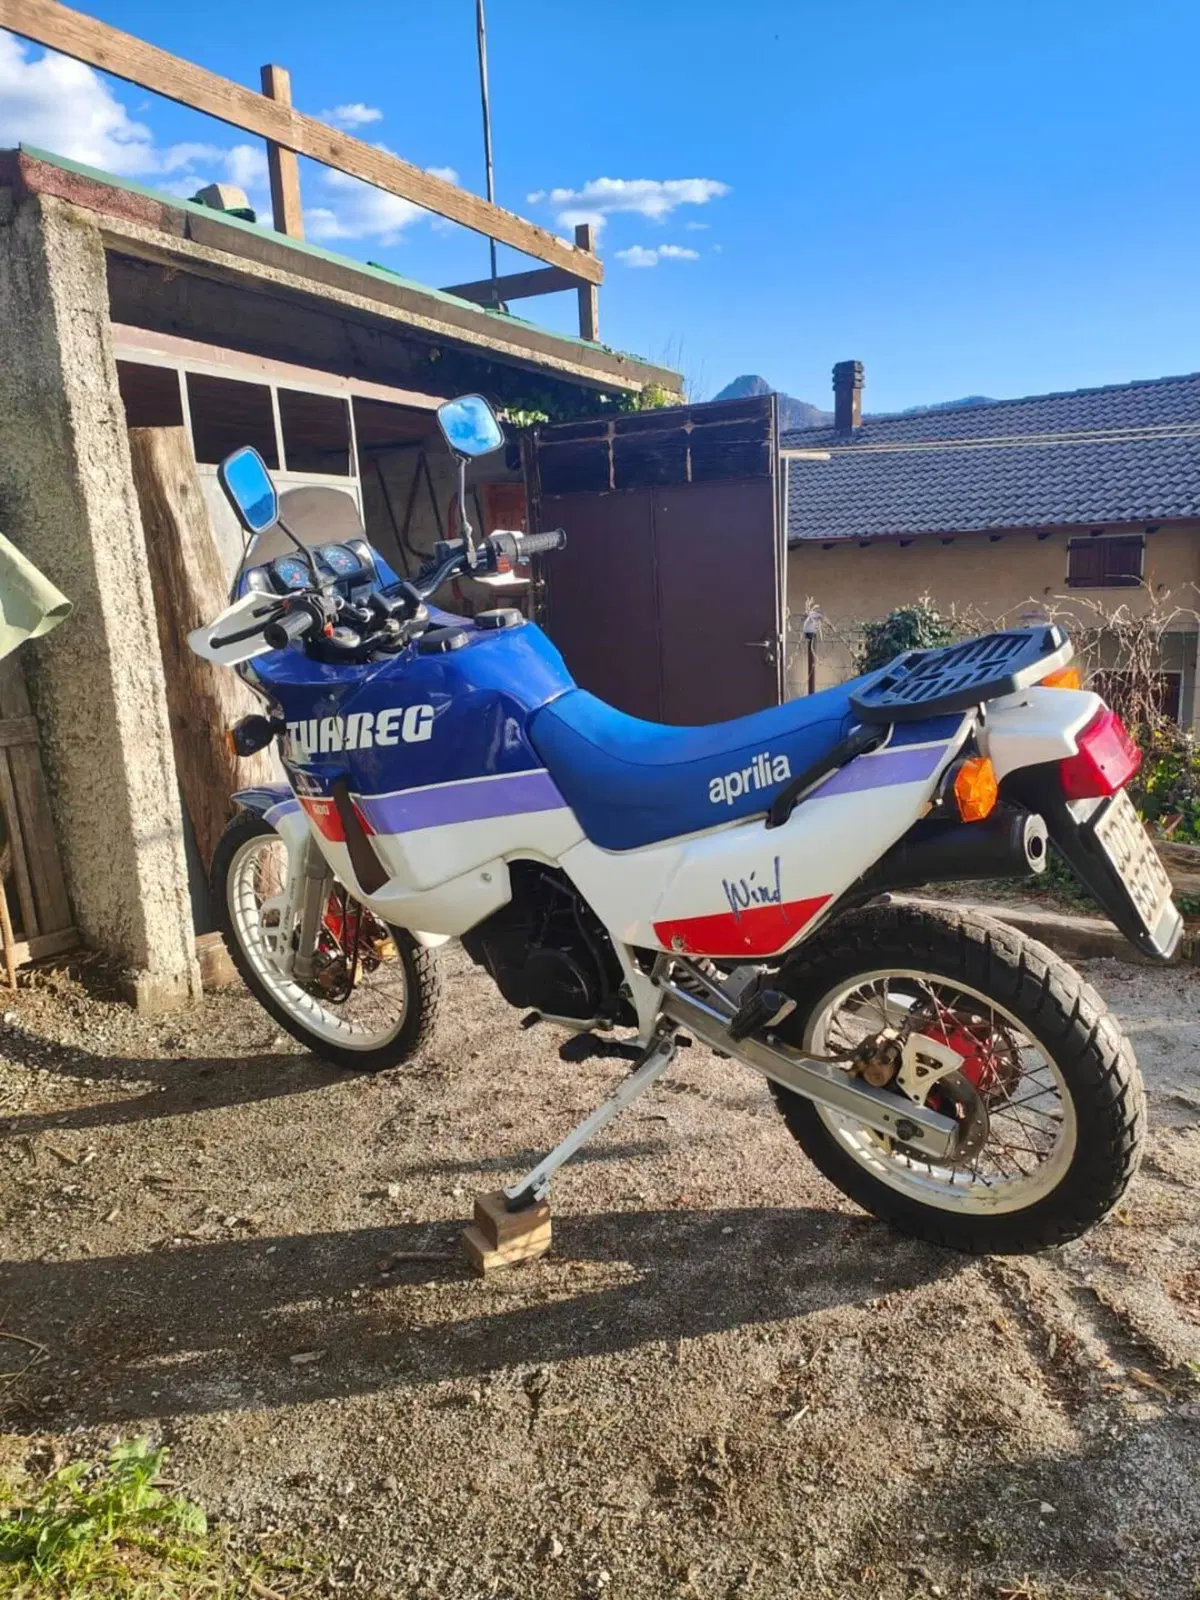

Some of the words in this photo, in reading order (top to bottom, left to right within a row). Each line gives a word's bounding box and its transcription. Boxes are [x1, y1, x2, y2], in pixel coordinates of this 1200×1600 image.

[286, 704, 434, 754] TUAREG
[708, 752, 791, 805] aprilia
[721, 855, 789, 925] Wind
